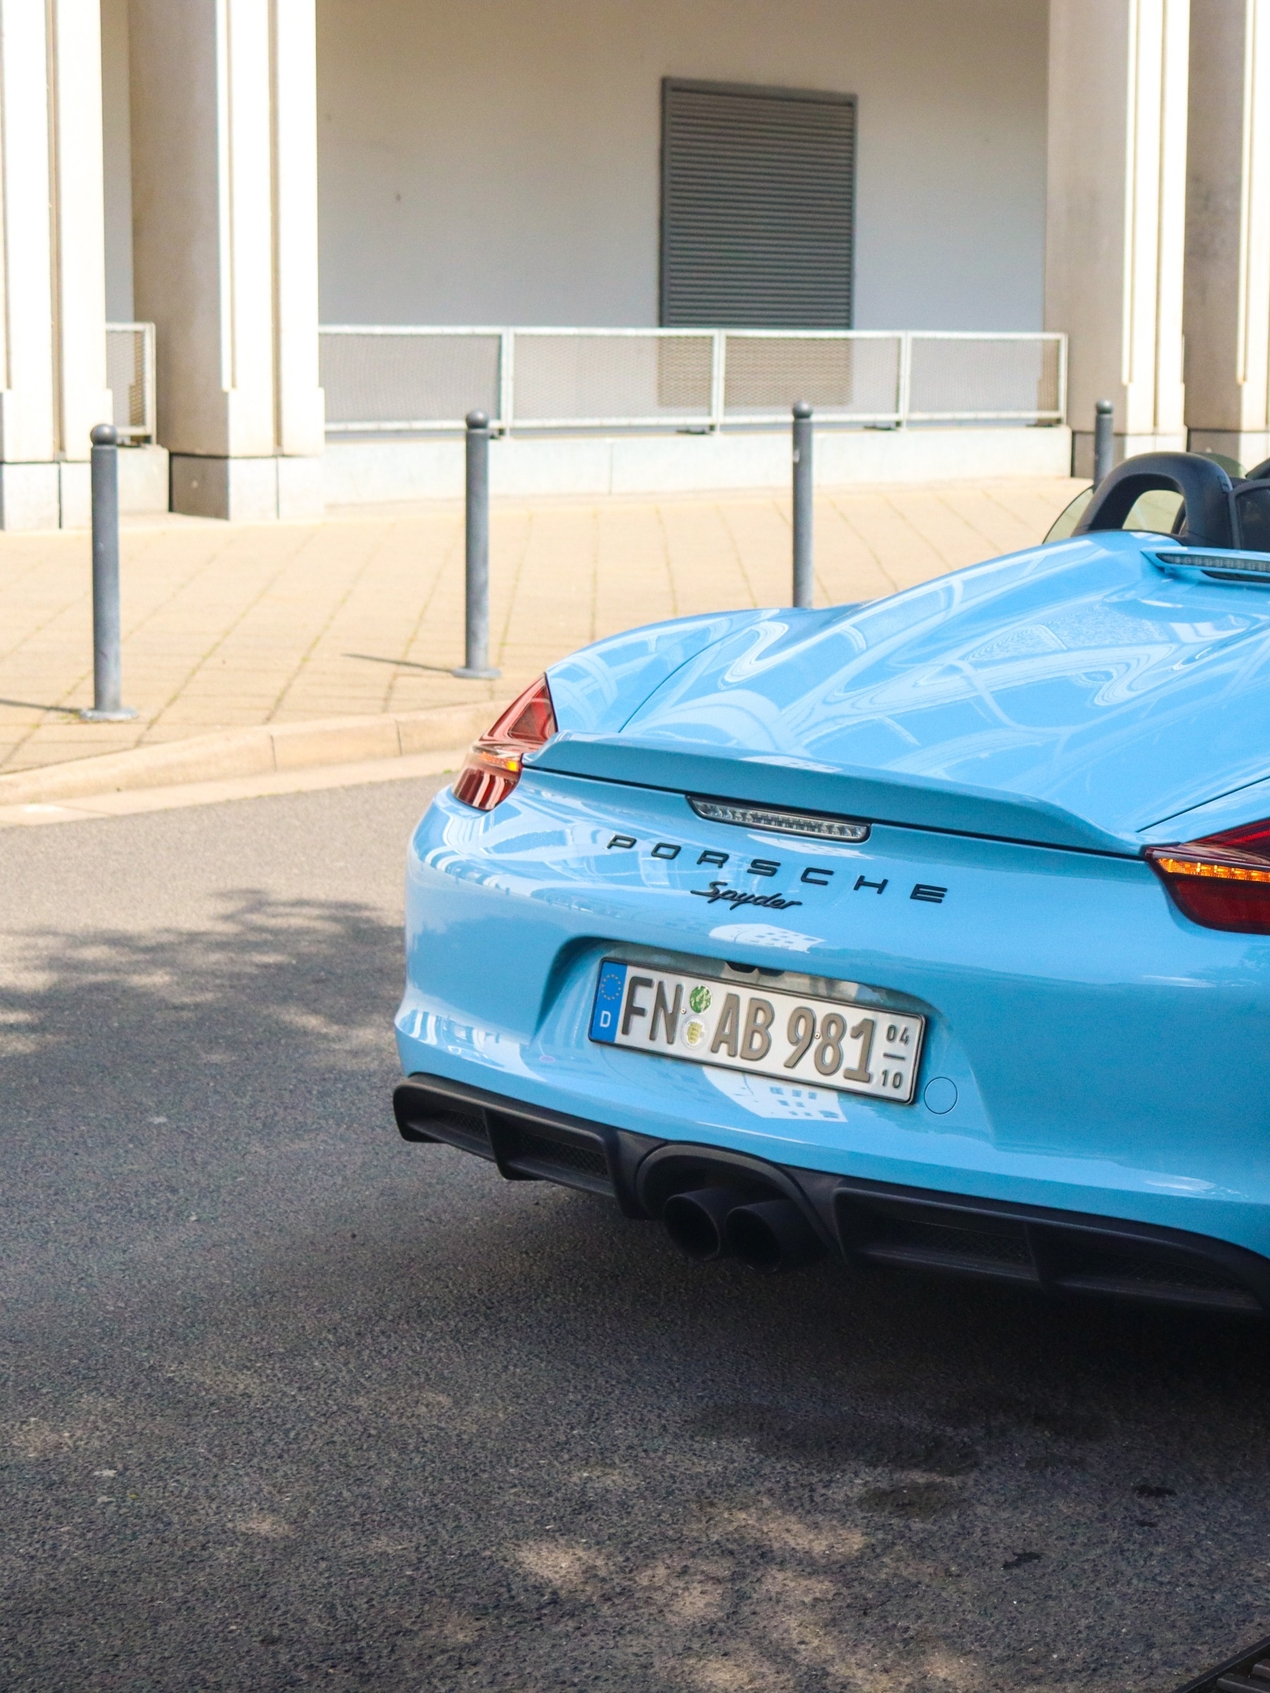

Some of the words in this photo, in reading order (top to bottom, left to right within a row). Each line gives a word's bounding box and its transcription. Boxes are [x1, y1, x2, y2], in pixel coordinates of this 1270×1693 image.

[606, 834, 948, 904] PORSCHE
[690, 881, 803, 911] Spyder
[599, 1009, 612, 1029] D
[621, 975, 685, 1045] FN
[710, 992, 776, 1062] AB
[783, 1005, 876, 1084] 981
[885, 1024, 910, 1046] 04
[881, 1068, 903, 1090] 10
